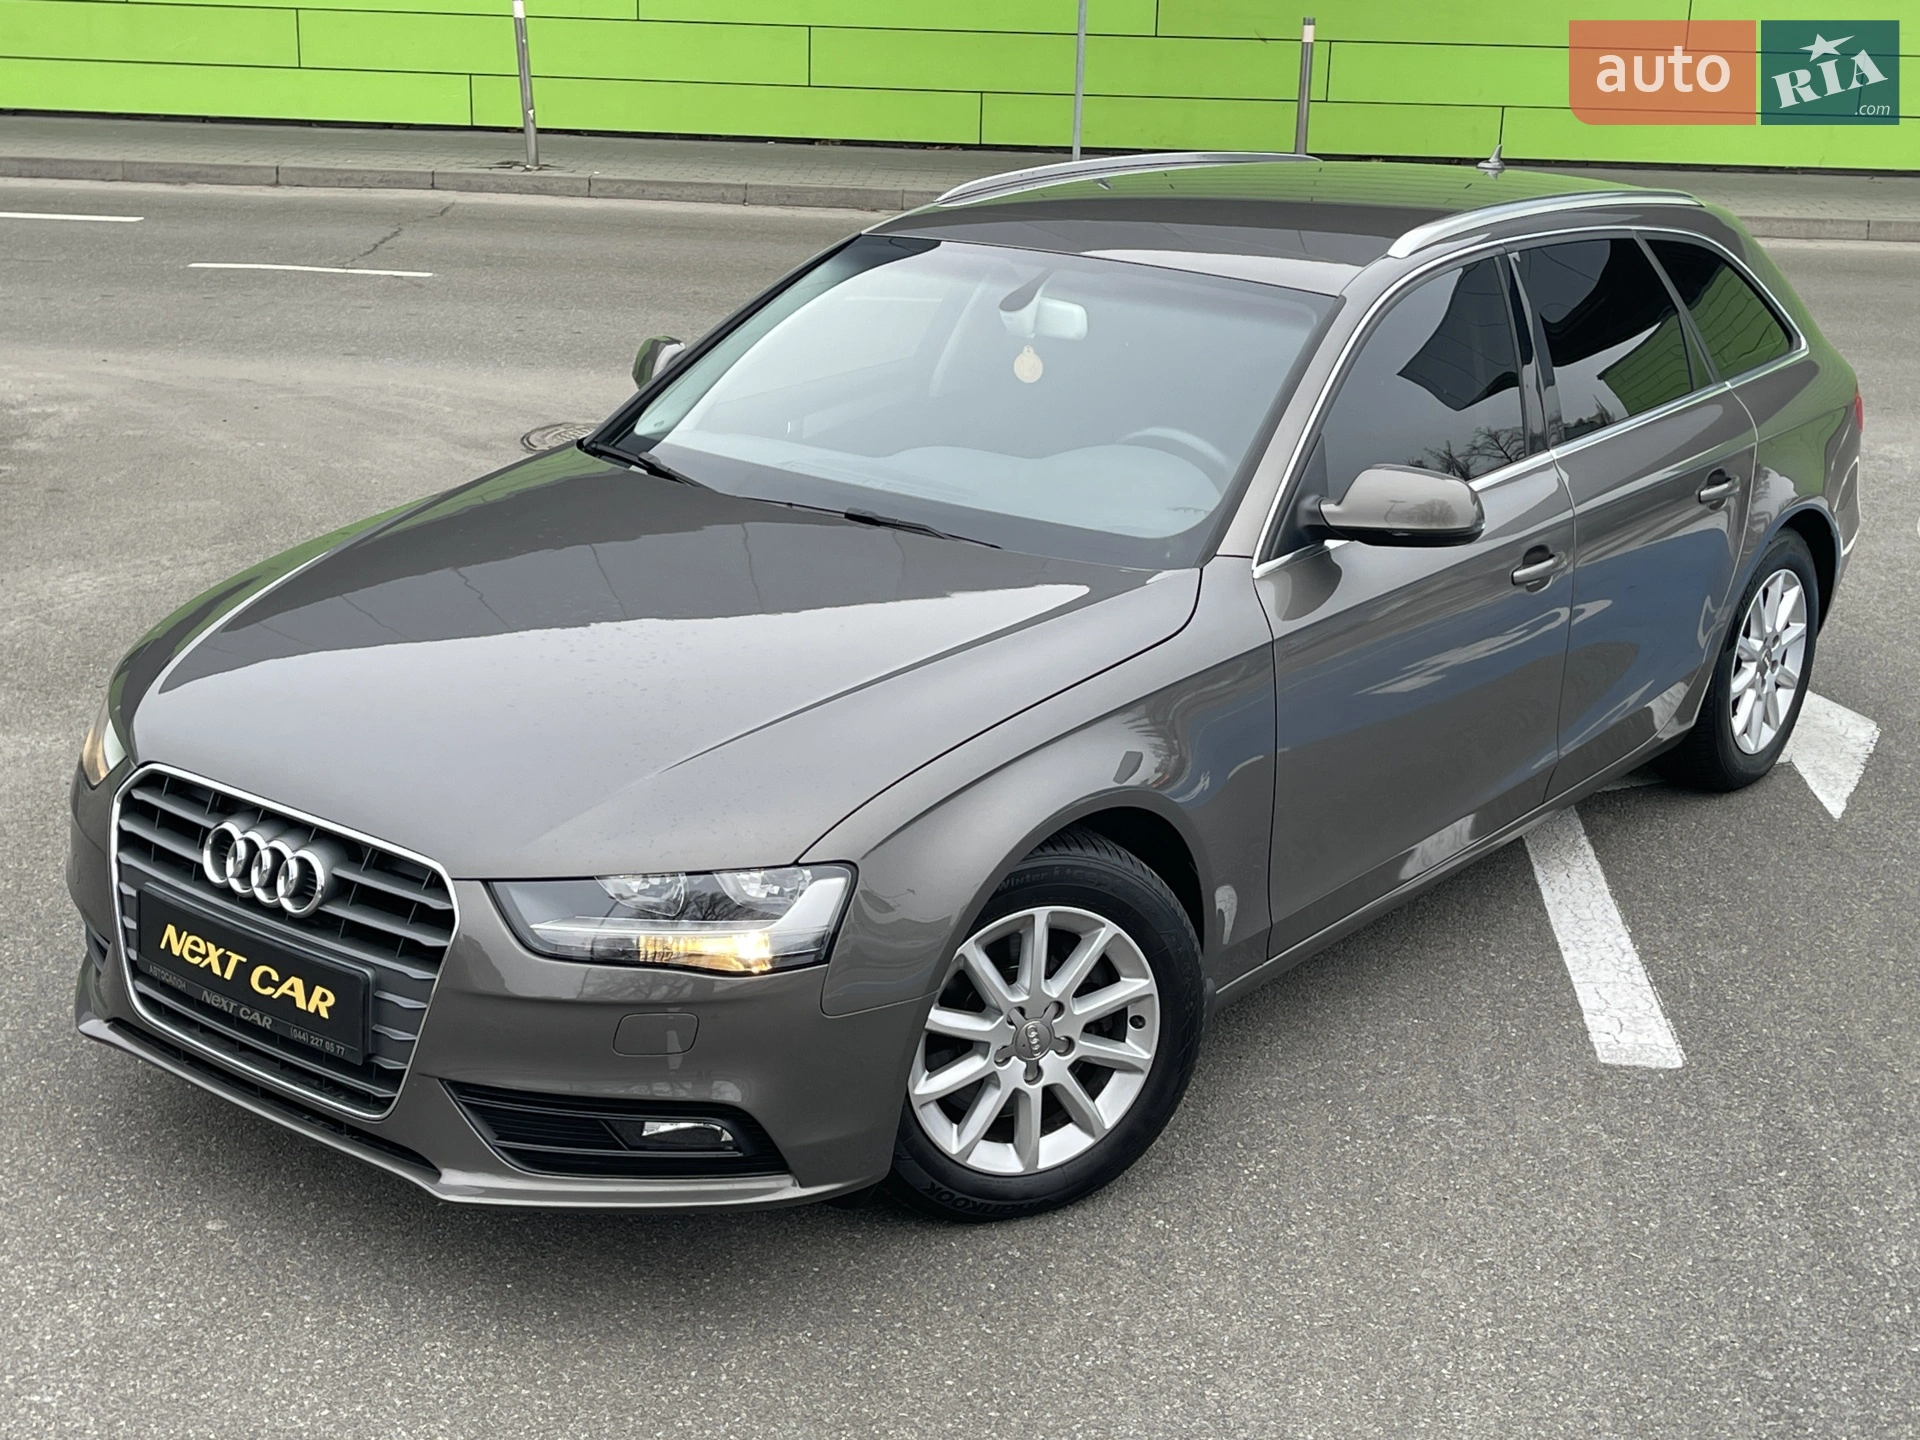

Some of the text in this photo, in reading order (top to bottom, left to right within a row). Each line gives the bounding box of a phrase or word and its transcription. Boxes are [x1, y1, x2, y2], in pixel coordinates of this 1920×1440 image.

[250, 965, 336, 1019] CAR
[239, 1007, 273, 1029] CAR
[290, 1026, 346, 1056] (044) 227 05 77
